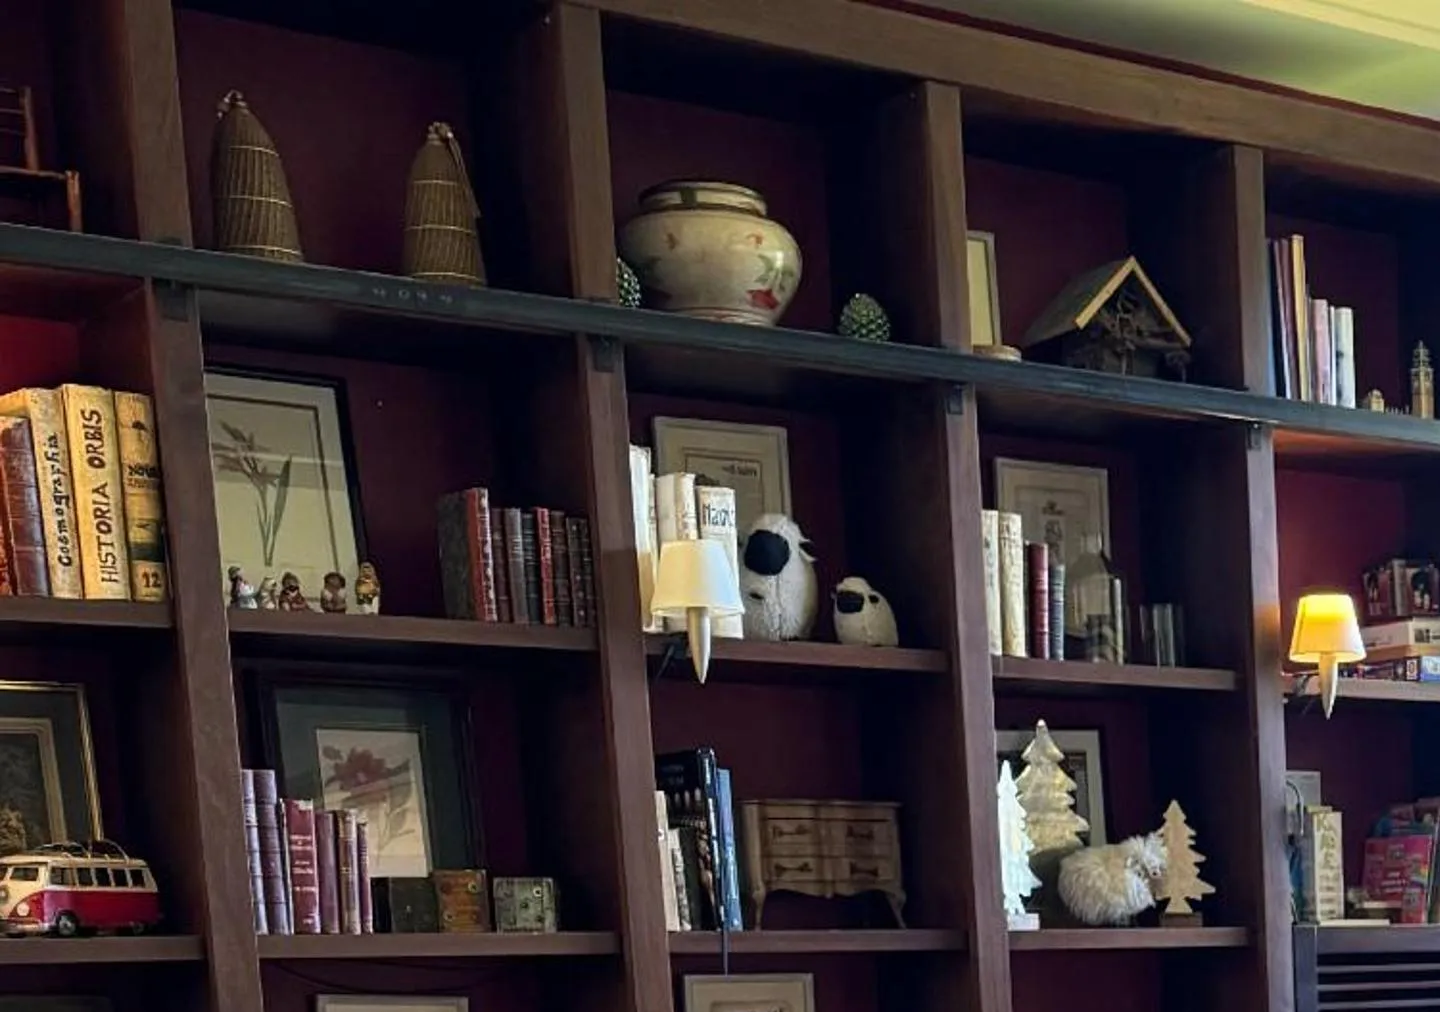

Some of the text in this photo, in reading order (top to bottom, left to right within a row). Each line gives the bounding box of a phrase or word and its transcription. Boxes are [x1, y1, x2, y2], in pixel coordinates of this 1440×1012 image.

[80, 408, 119, 584] HISTORIA ORBIS
[142, 570, 161, 589] 12
